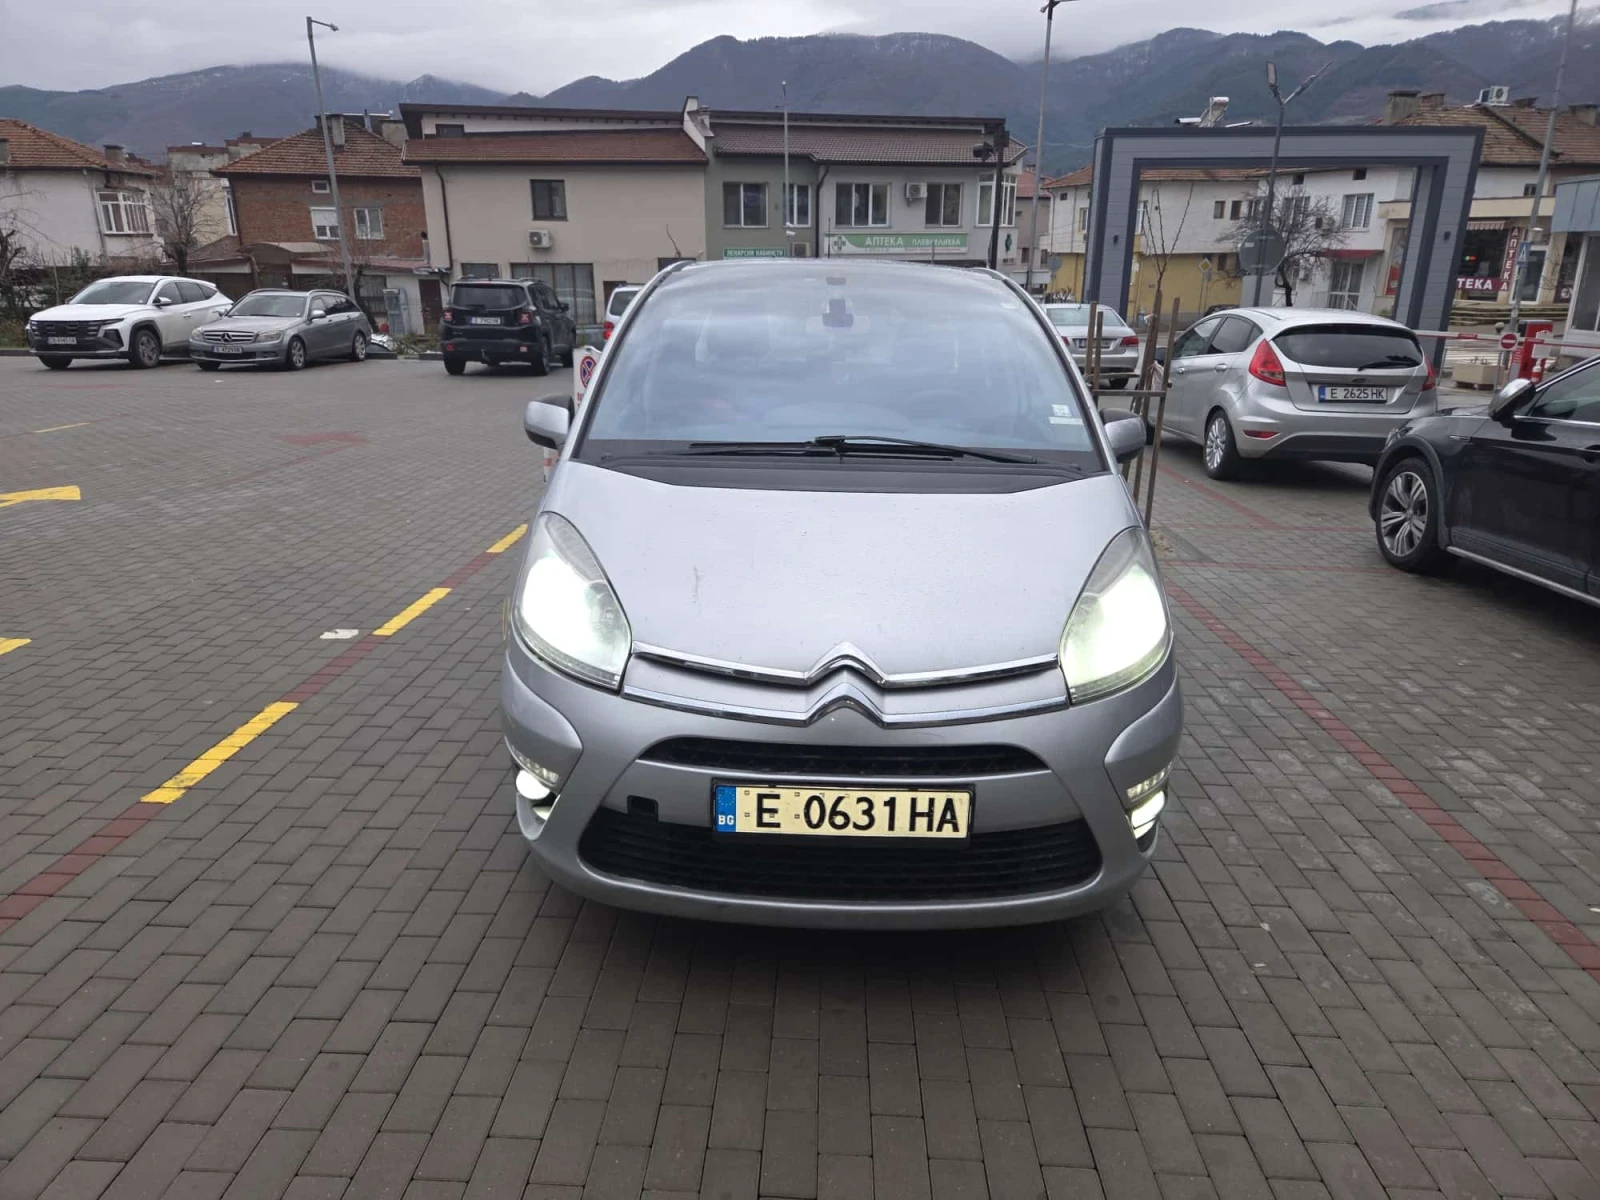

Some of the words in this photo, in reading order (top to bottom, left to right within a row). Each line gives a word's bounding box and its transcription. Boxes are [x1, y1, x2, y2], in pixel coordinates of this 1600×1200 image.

[864, 236, 904, 246] АПТЕКА
[1501, 227, 1520, 291] АПТЕКА
[1456, 277, 1493, 290] ТЕКА
[756, 793, 781, 829] E
[718, 814, 735, 826] BG
